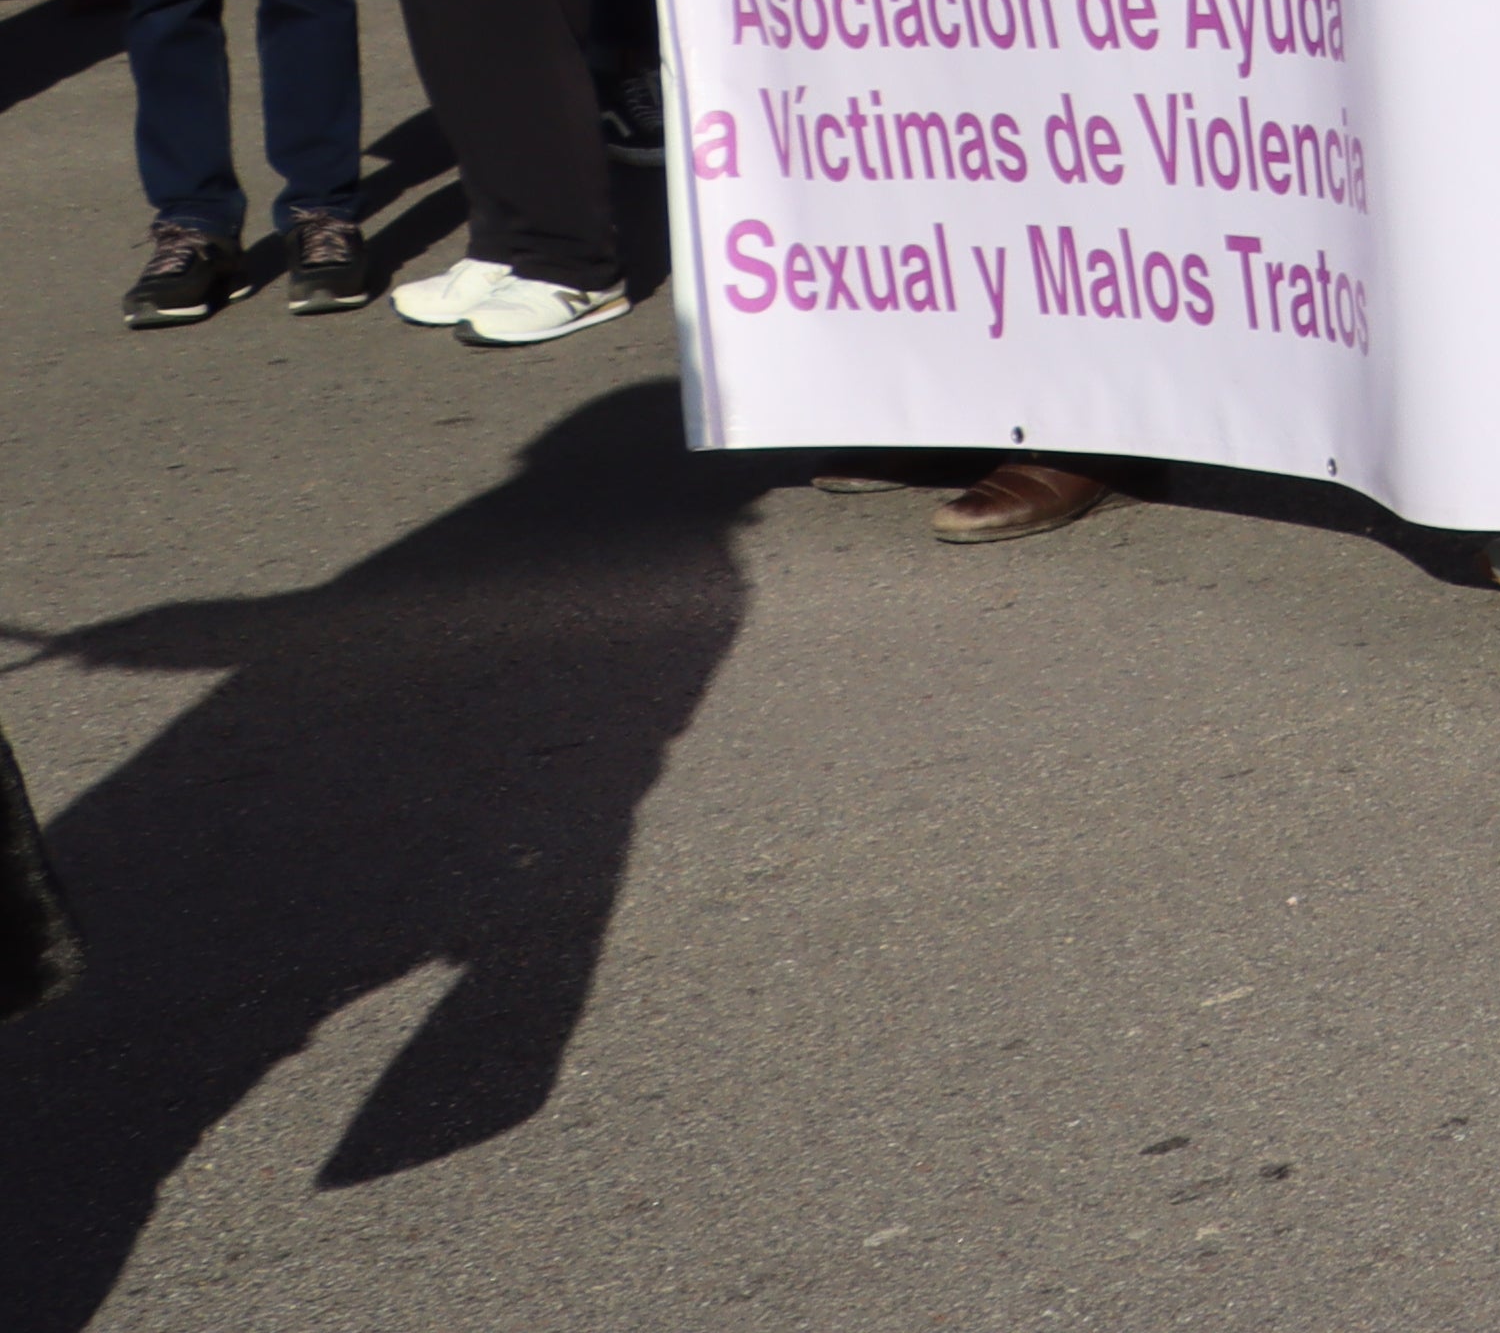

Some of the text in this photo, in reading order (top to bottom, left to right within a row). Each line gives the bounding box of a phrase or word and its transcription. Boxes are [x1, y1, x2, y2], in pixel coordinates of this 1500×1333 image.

[691, 84, 1369, 216] a Víctimas de Violencia
[723, 218, 1370, 358] Sexual y Malos Tratos
